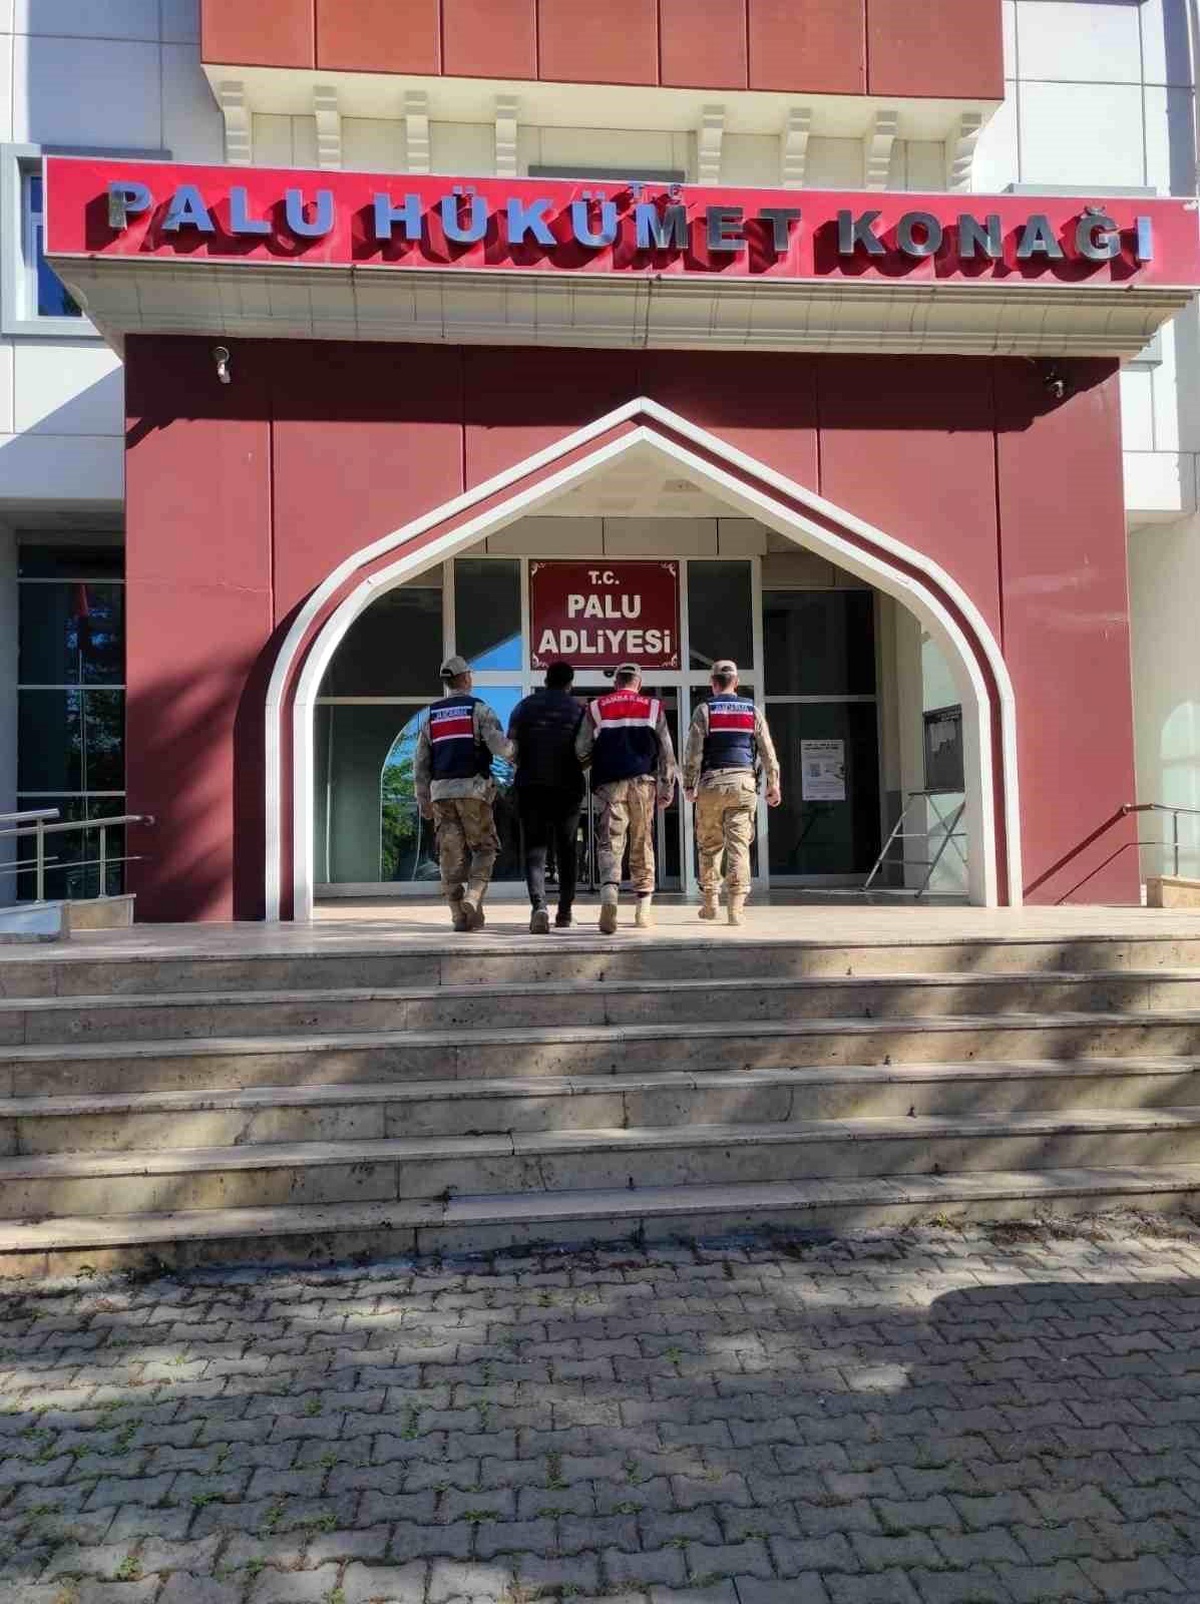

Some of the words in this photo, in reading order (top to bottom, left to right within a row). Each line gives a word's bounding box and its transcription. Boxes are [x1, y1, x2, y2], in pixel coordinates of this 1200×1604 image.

[108, 180, 335, 238] PALU
[373, 185, 801, 252] HÜKÜMET
[837, 204, 1155, 262] KONAĞI
[588, 571, 620, 585] T.C.
[567, 594, 642, 619] PALU
